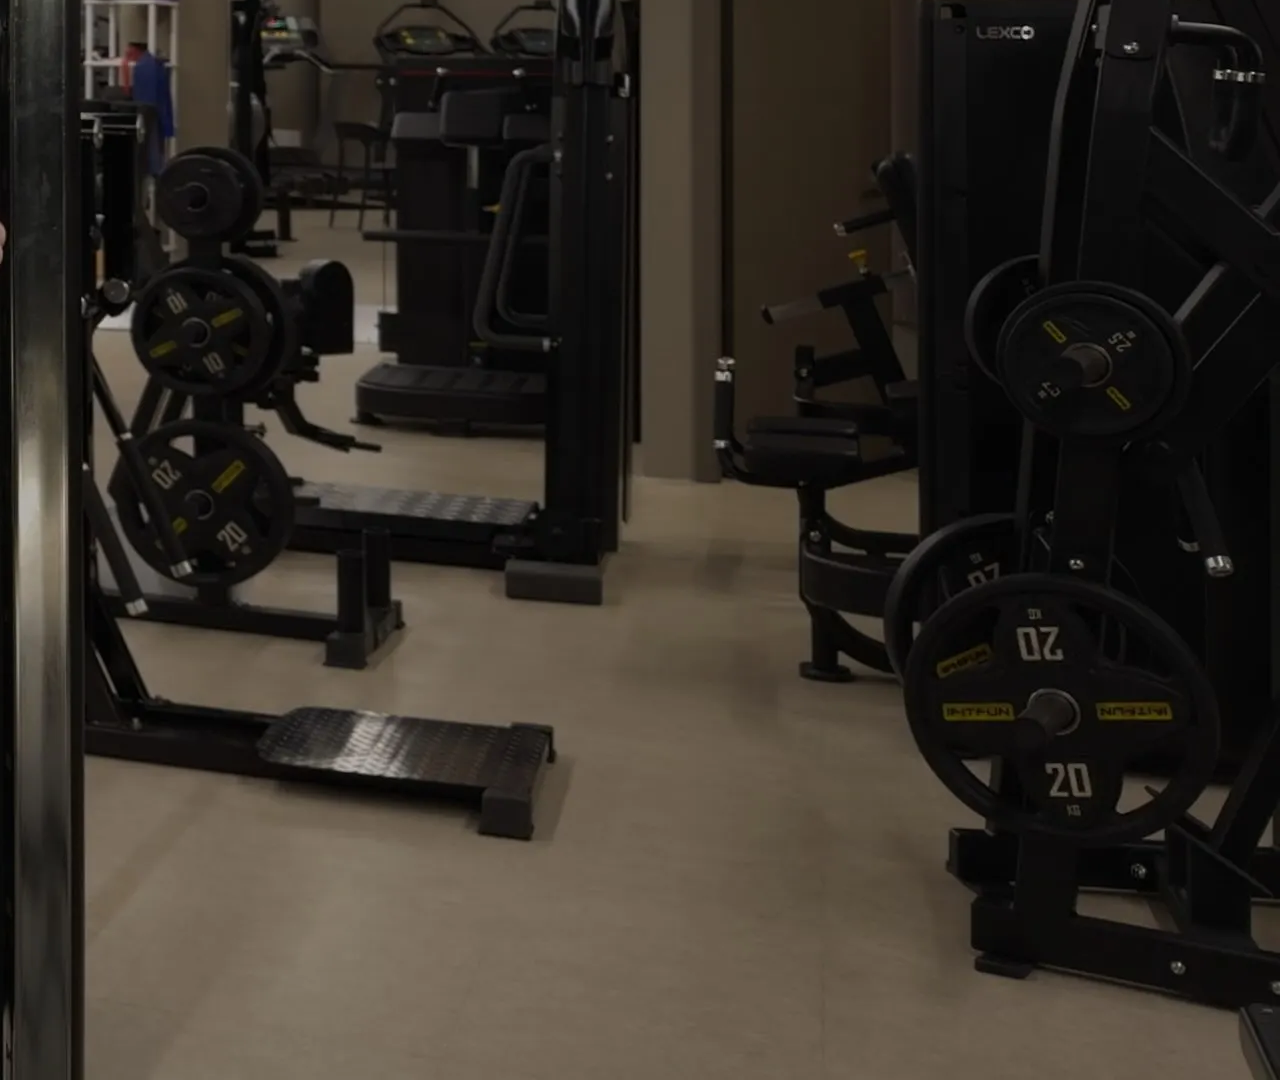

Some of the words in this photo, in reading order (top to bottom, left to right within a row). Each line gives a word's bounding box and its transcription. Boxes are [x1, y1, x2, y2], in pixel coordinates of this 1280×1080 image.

[975, 24, 1036, 41] LEXCO
[151, 458, 184, 491] 20
[215, 519, 250, 554] 20
[1015, 625, 1065, 662] 20
[1043, 761, 1094, 798] 20
